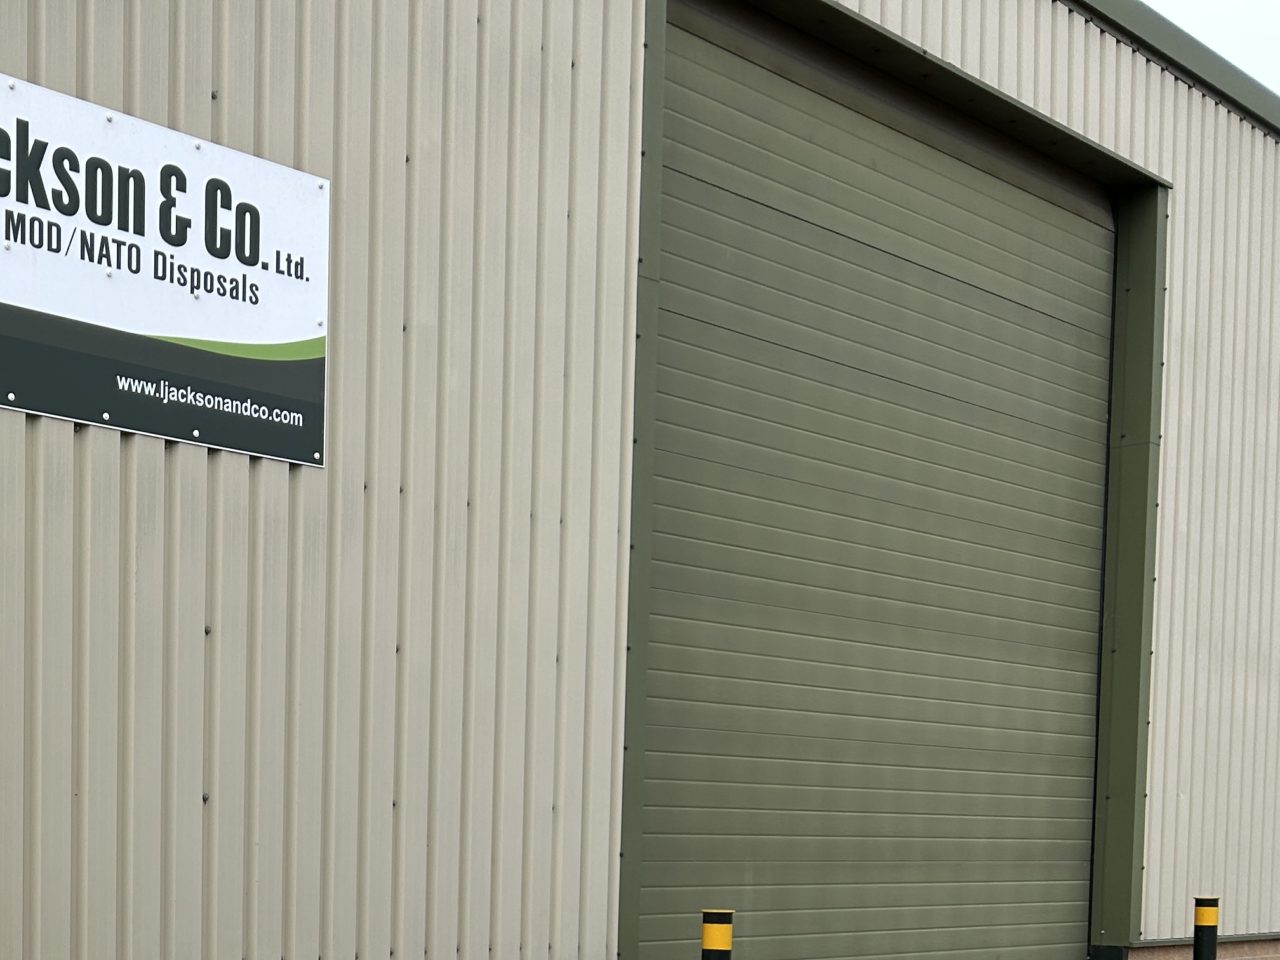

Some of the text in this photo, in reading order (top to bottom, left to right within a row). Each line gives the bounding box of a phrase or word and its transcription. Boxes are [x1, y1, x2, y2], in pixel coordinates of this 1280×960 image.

[5, 209, 141, 275] MOD/NATO
[153, 249, 260, 305] Disposals
[159, 164, 192, 247] &
[204, 177, 269, 271] Co.
[275, 250, 310, 282] Ltd.
[117, 374, 303, 427] www.ljacksonandco.com
